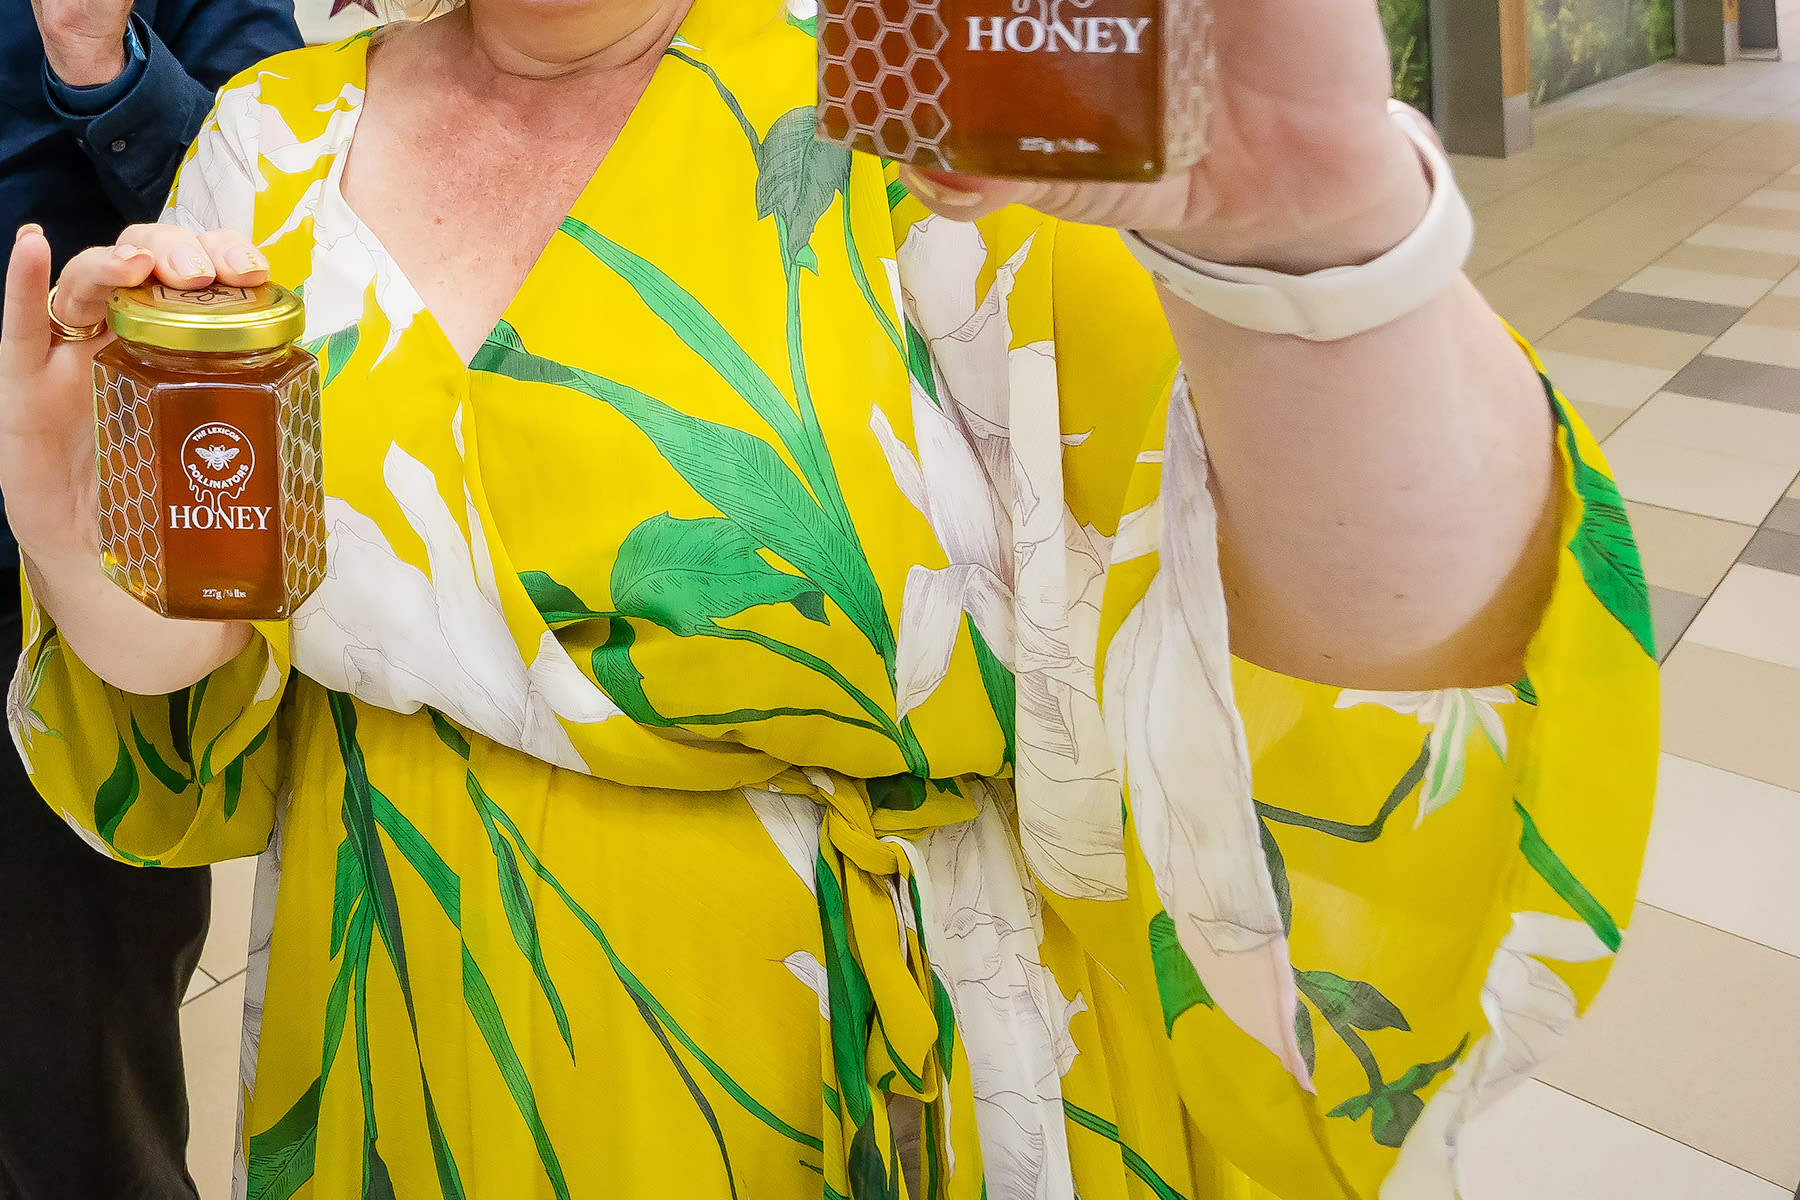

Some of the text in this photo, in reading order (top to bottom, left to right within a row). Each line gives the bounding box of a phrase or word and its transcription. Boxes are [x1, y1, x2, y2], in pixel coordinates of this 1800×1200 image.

[966, 15, 1151, 54] HONEY
[192, 427, 241, 442] THE LEXICON
[187, 463, 249, 489] POLLINATORS
[168, 505, 273, 531] HONEY
